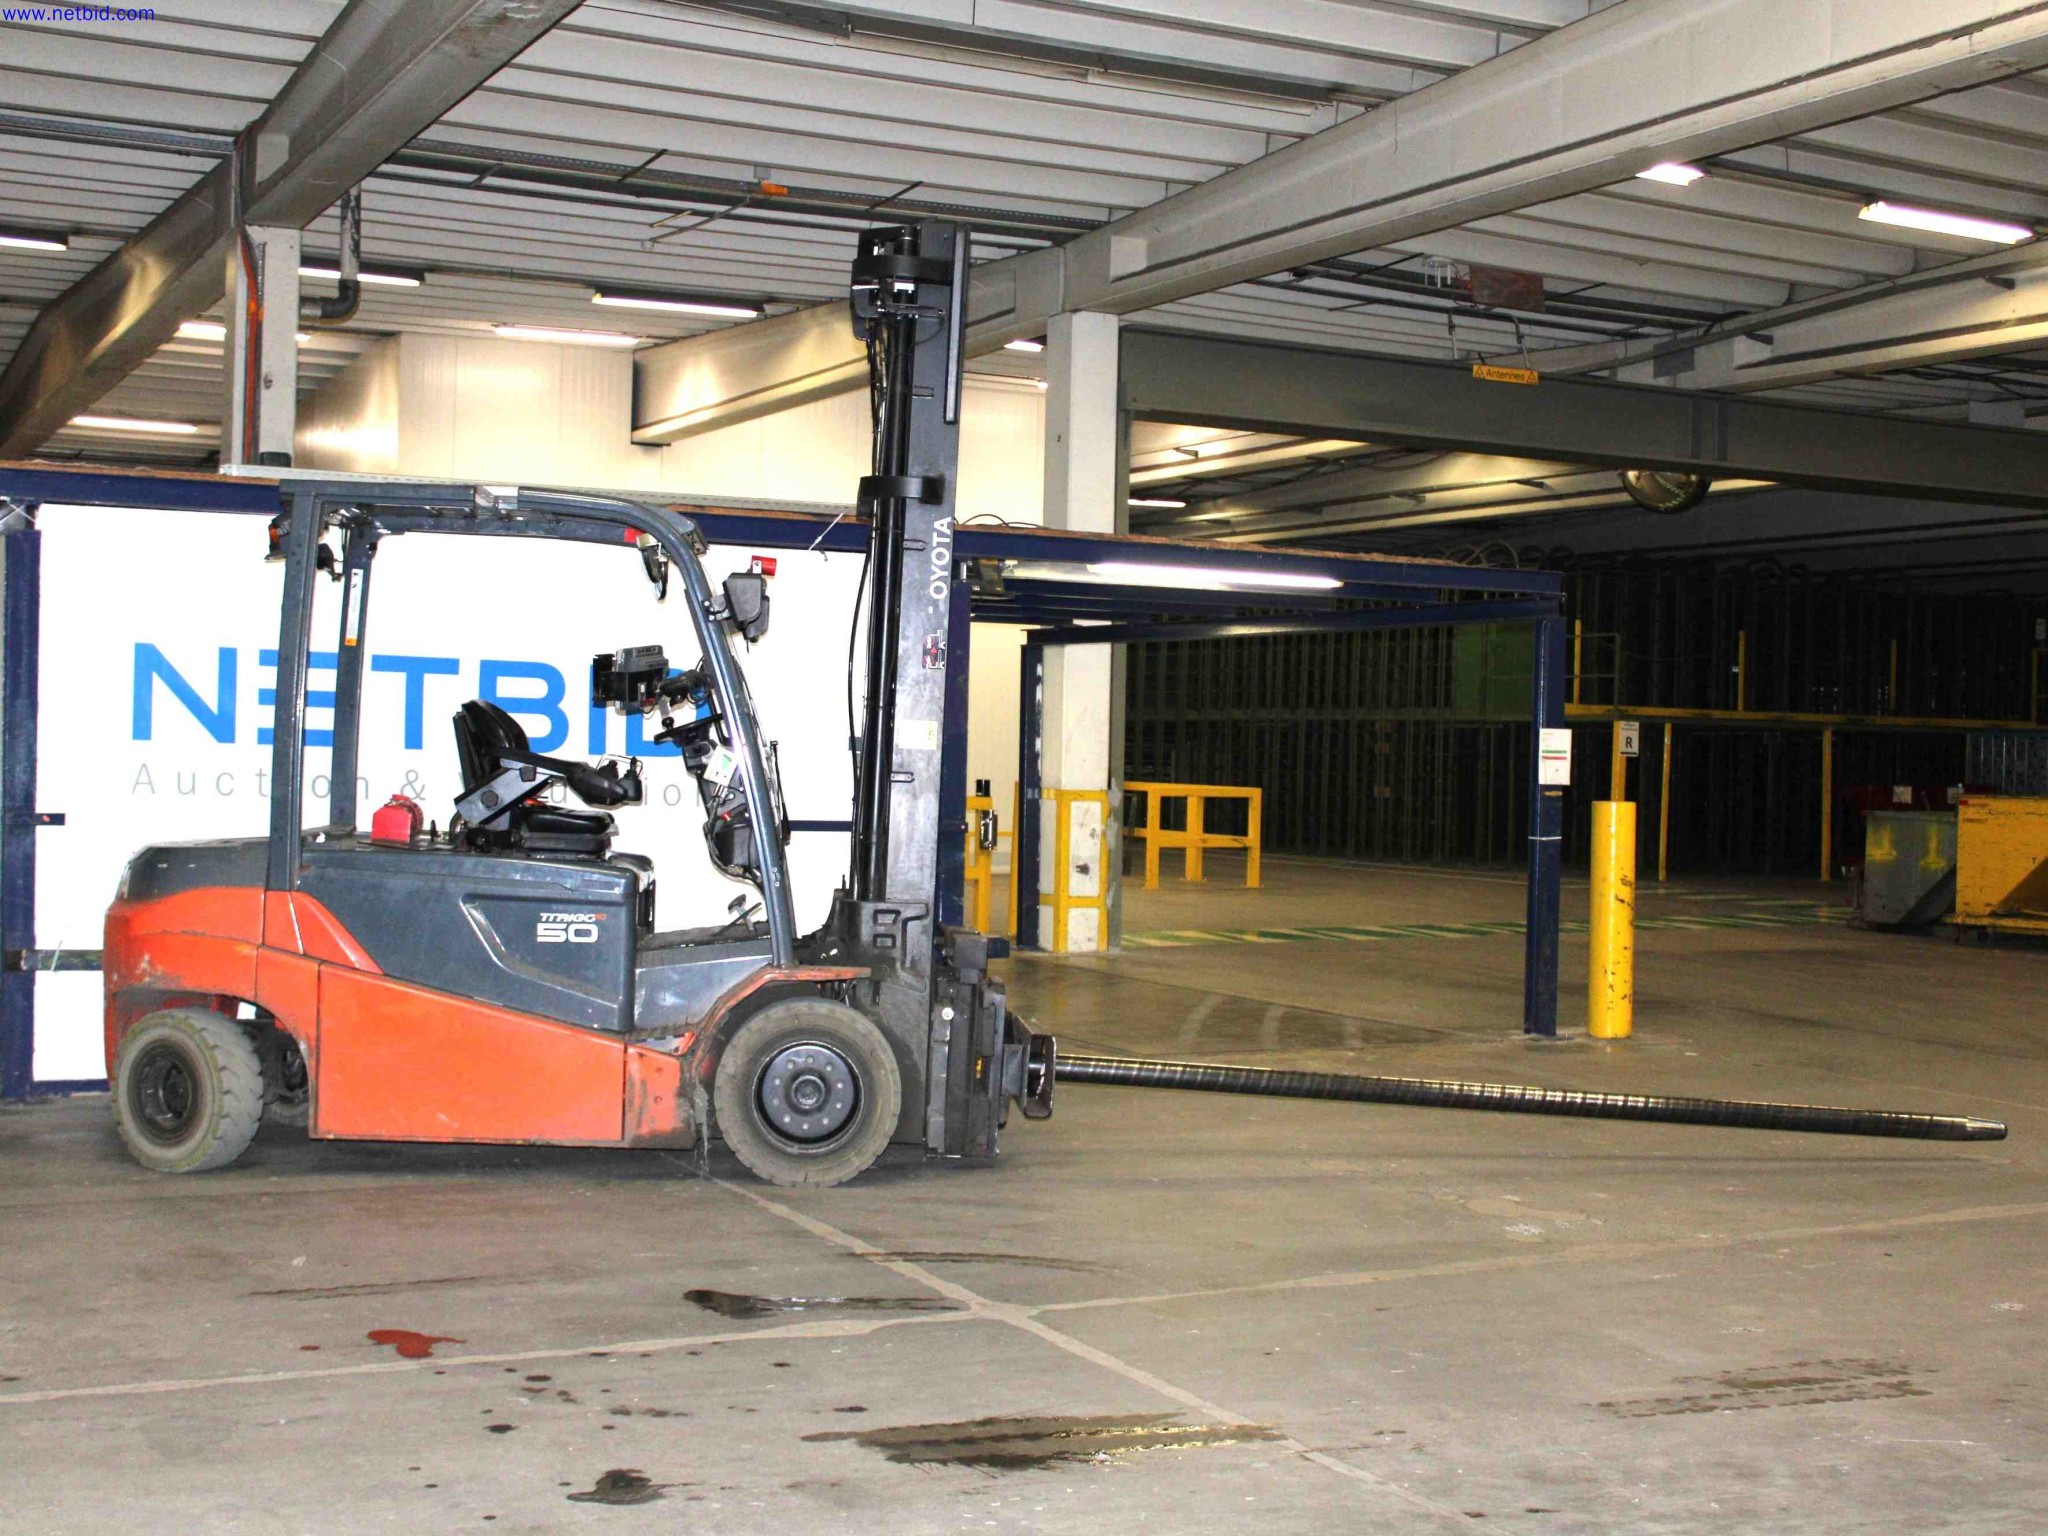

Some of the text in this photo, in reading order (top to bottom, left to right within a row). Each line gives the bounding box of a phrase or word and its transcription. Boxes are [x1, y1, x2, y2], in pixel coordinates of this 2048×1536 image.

[1486, 368, 1525, 380] Antennes
[927, 516, 952, 614] OYOTA
[1625, 736, 1633, 749] R
[131, 762, 369, 800] Aucton
[400, 769, 426, 801] &
[537, 923, 599, 943] 50
